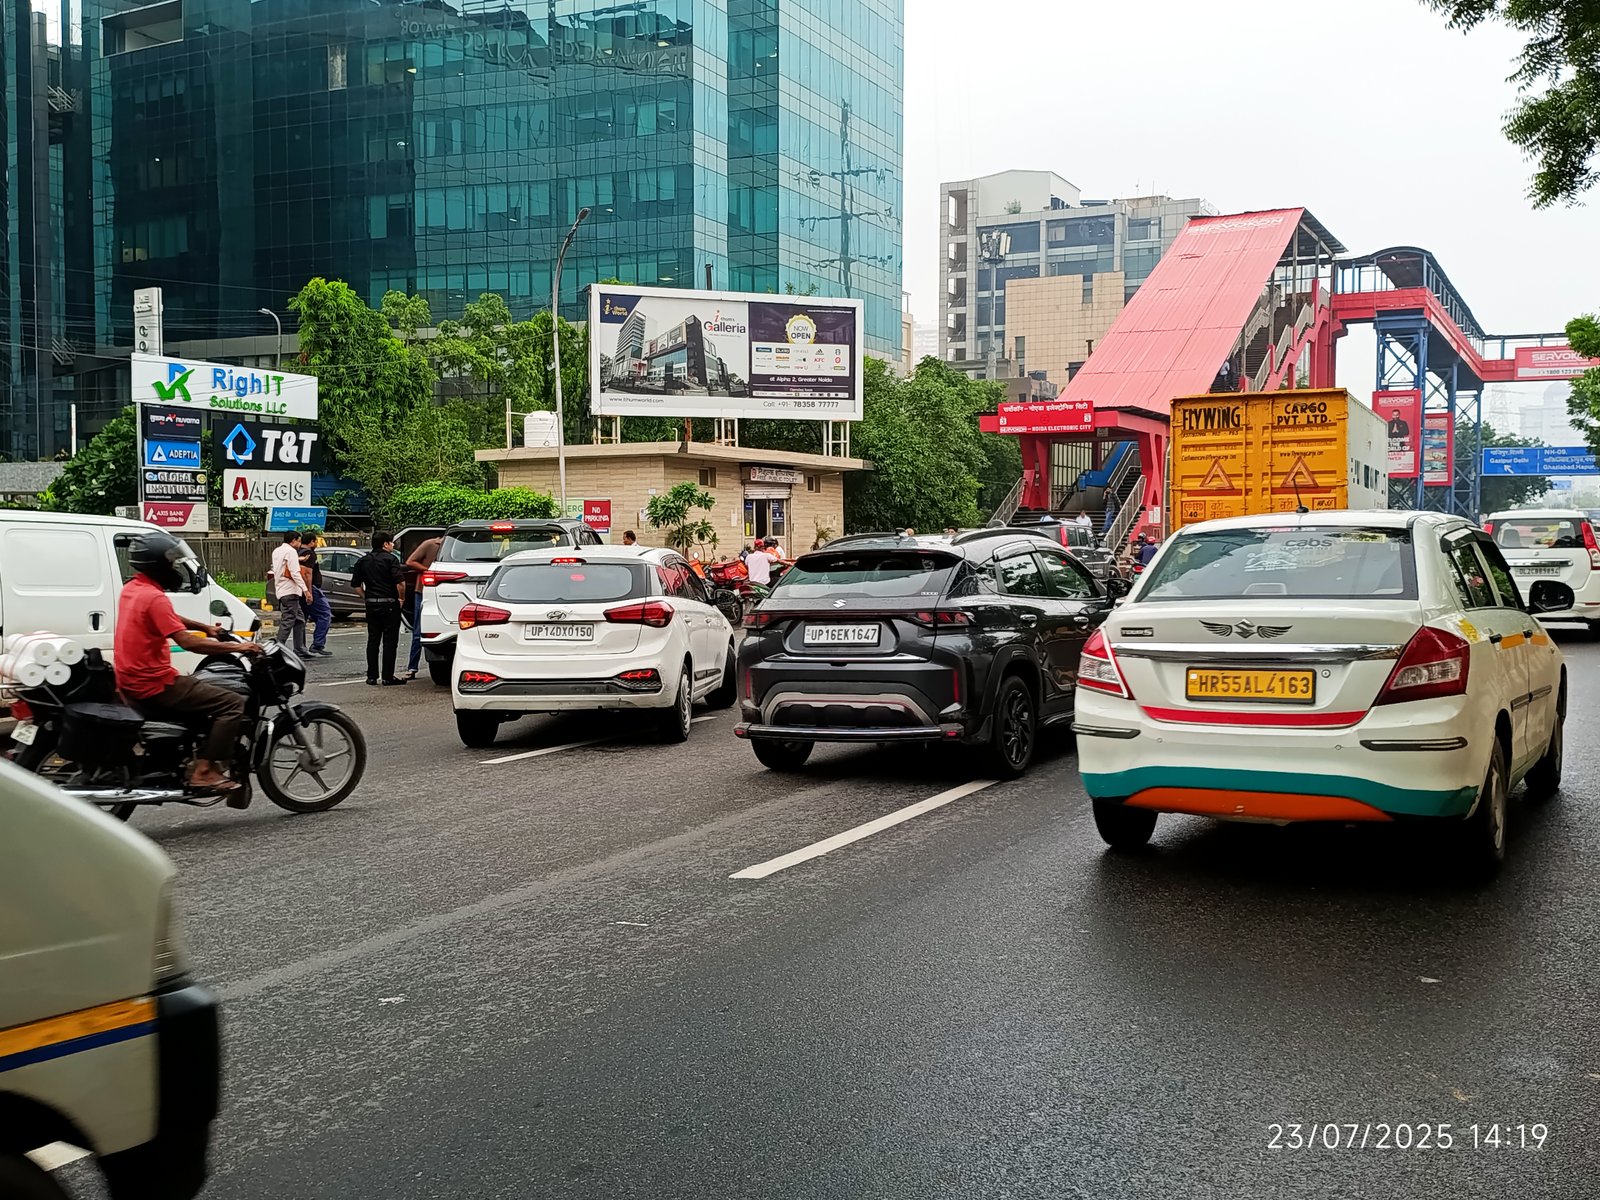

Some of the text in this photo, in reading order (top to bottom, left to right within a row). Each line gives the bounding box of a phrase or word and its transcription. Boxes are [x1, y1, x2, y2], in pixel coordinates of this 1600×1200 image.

[703, 321, 746, 334] Galleria
[790, 332, 811, 340] OPEN
[211, 367, 285, 397] RighIT
[209, 395, 287, 415] Solutions LLC
[1284, 402, 1328, 415] CARGO
[1182, 405, 1241, 430] FLYWING
[1277, 414, 1332, 426] PVT. LTD.
[261, 429, 318, 464] T&T
[169, 449, 199, 460] ADEPTIA
[157, 472, 195, 483] GLOBAL
[249, 480, 304, 502] AEGIS
[1285, 537, 1333, 547] cabs
[531, 626, 592, 637] UP14DX0150
[811, 628, 878, 640] UP16EK1647
[1199, 673, 1311, 695] HR55AL4163
